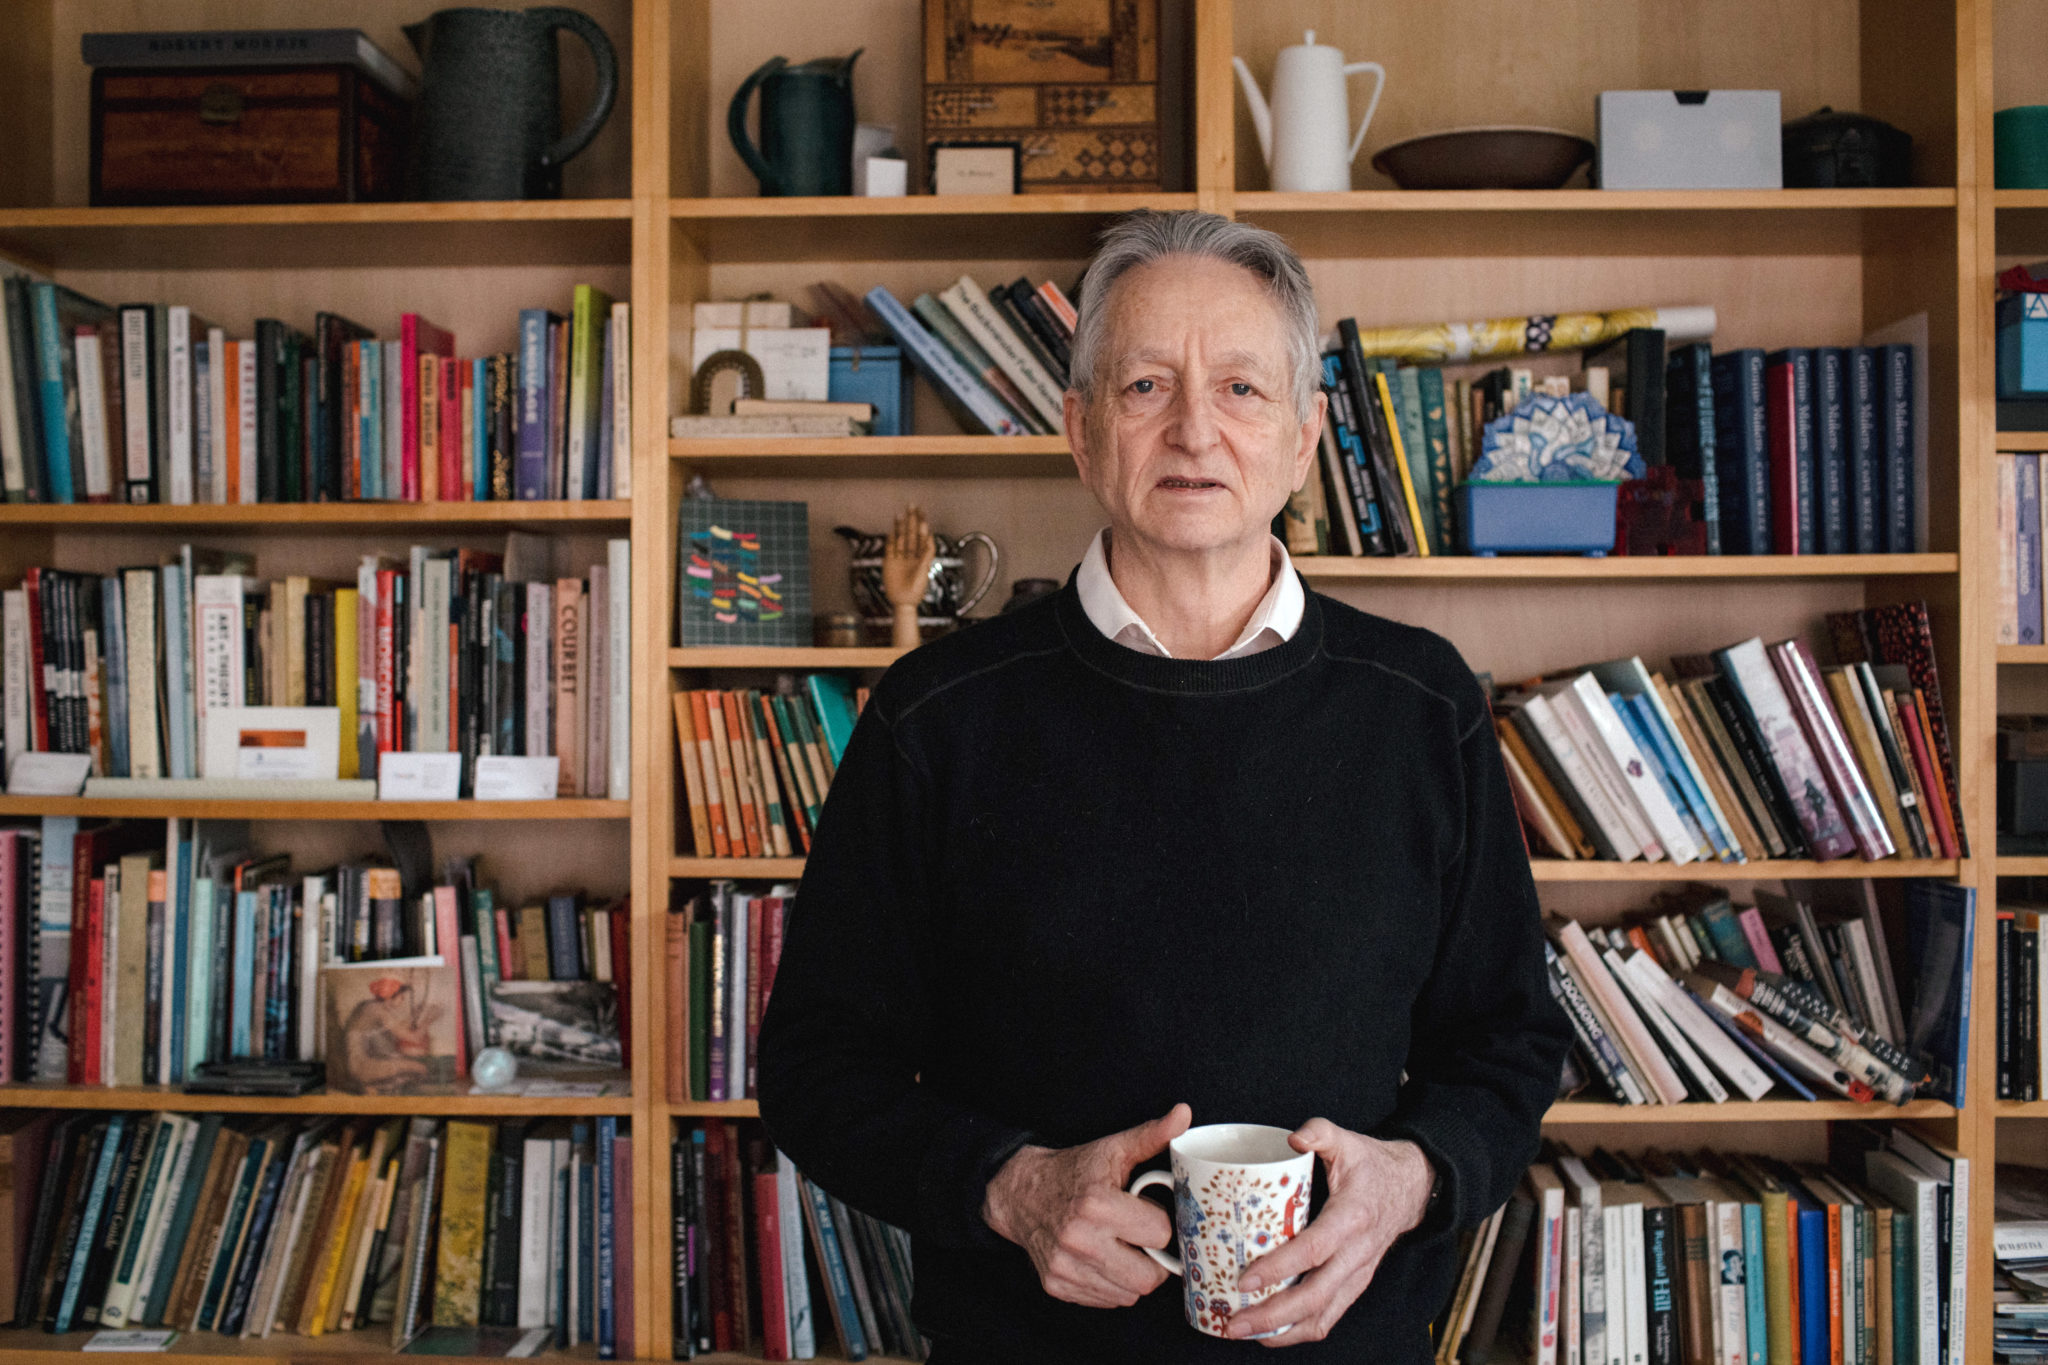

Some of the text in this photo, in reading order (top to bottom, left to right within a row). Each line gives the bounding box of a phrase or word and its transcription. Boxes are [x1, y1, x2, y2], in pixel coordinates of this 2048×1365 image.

[970, 300, 1020, 358] Buckminster
[524, 318, 540, 425] LANGUAGE
[1751, 355, 1763, 403] Genius
[1797, 355, 1806, 401] Genius
[1826, 354, 1837, 401] Genius
[1858, 354, 1869, 400] Genius
[1894, 351, 1904, 397] Genius
[1753, 405, 1763, 453] Makers
[1798, 404, 1809, 451] Makers
[1827, 403, 1838, 450] Makers
[1859, 403, 1870, 450] Makers
[1894, 400, 1904, 448] Makers
[218, 612, 230, 641] ART
[560, 604, 578, 697] COURBET
[379, 626, 392, 716] MOSCOW
[1558, 976, 1603, 1039] DOGSONG
[132, 1123, 150, 1162] British
[115, 1163, 138, 1214] Museum
[103, 1212, 124, 1250] Guide
[1921, 1215, 1934, 1274] SCIENTIST
[1953, 1215, 1964, 1276] OSTEOPENIA
[1653, 1229, 1671, 1311] Reginald Hill
[1922, 1295, 1934, 1330] REBEL
